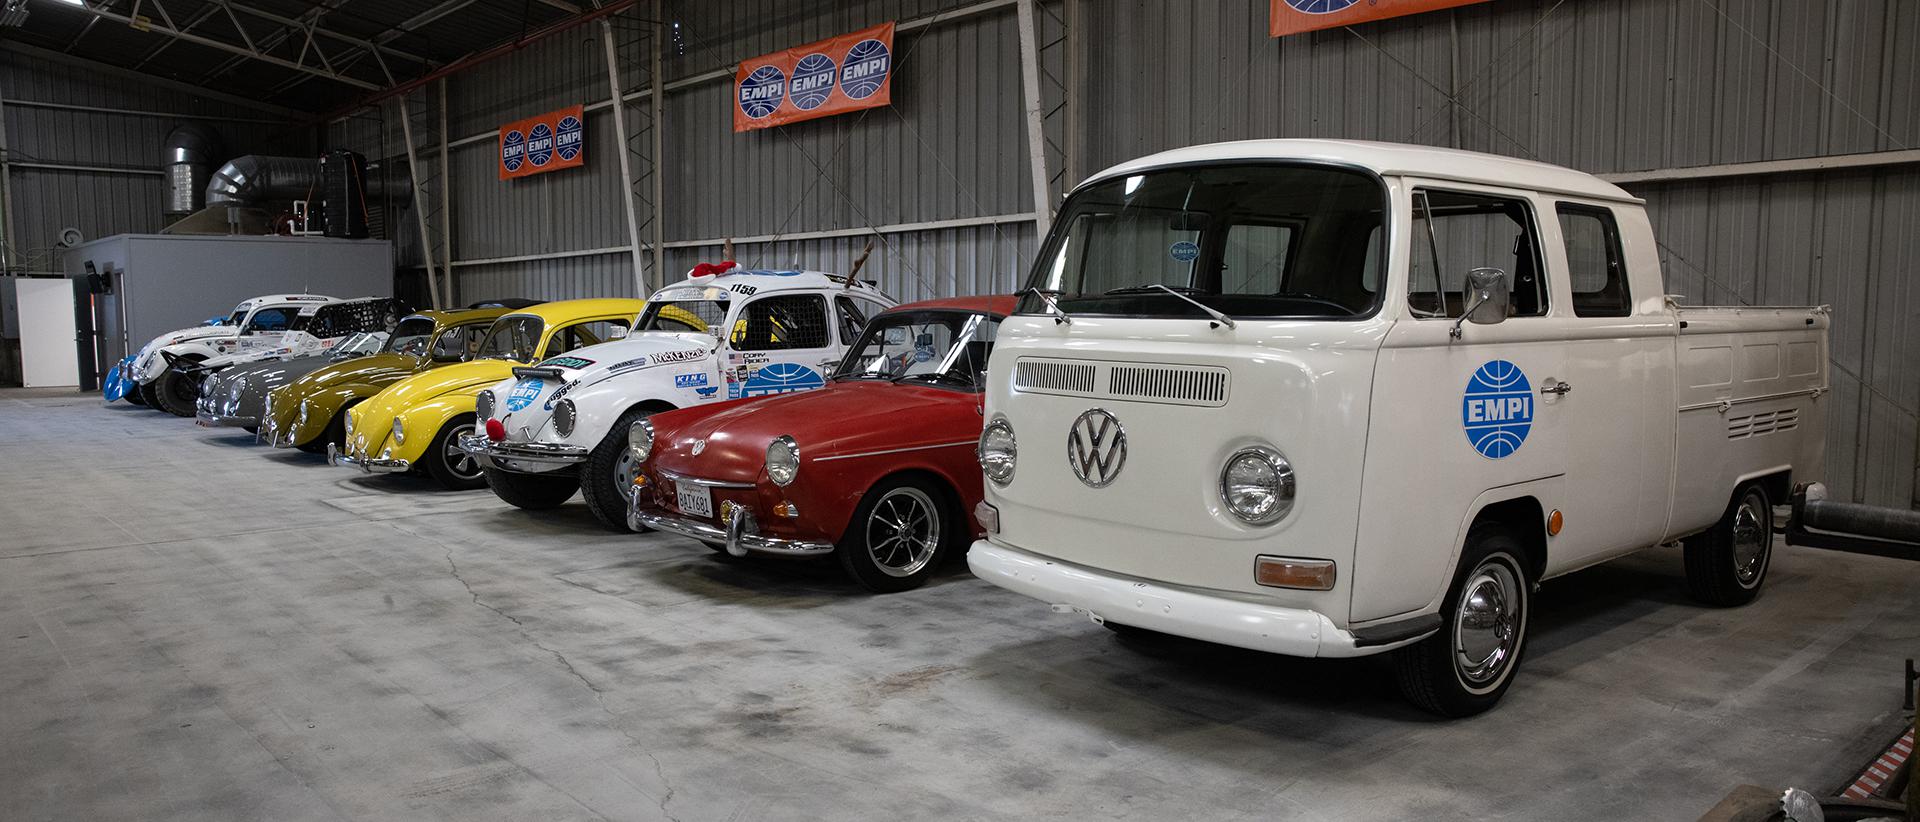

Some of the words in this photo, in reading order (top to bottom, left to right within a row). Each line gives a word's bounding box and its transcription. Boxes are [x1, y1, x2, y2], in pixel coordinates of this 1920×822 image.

[741, 82, 783, 101] EMPI
[792, 71, 834, 92] EMPI
[842, 57, 886, 81] EMPI
[503, 144, 524, 158] EMPI
[528, 137, 552, 152] EMPI
[557, 130, 581, 146] EMPI
[730, 283, 758, 296] 1159
[677, 374, 706, 382] KING
[511, 388, 539, 400] EMPI
[1467, 397, 1530, 423] EMPI
[679, 492, 710, 513] 8AIY681
